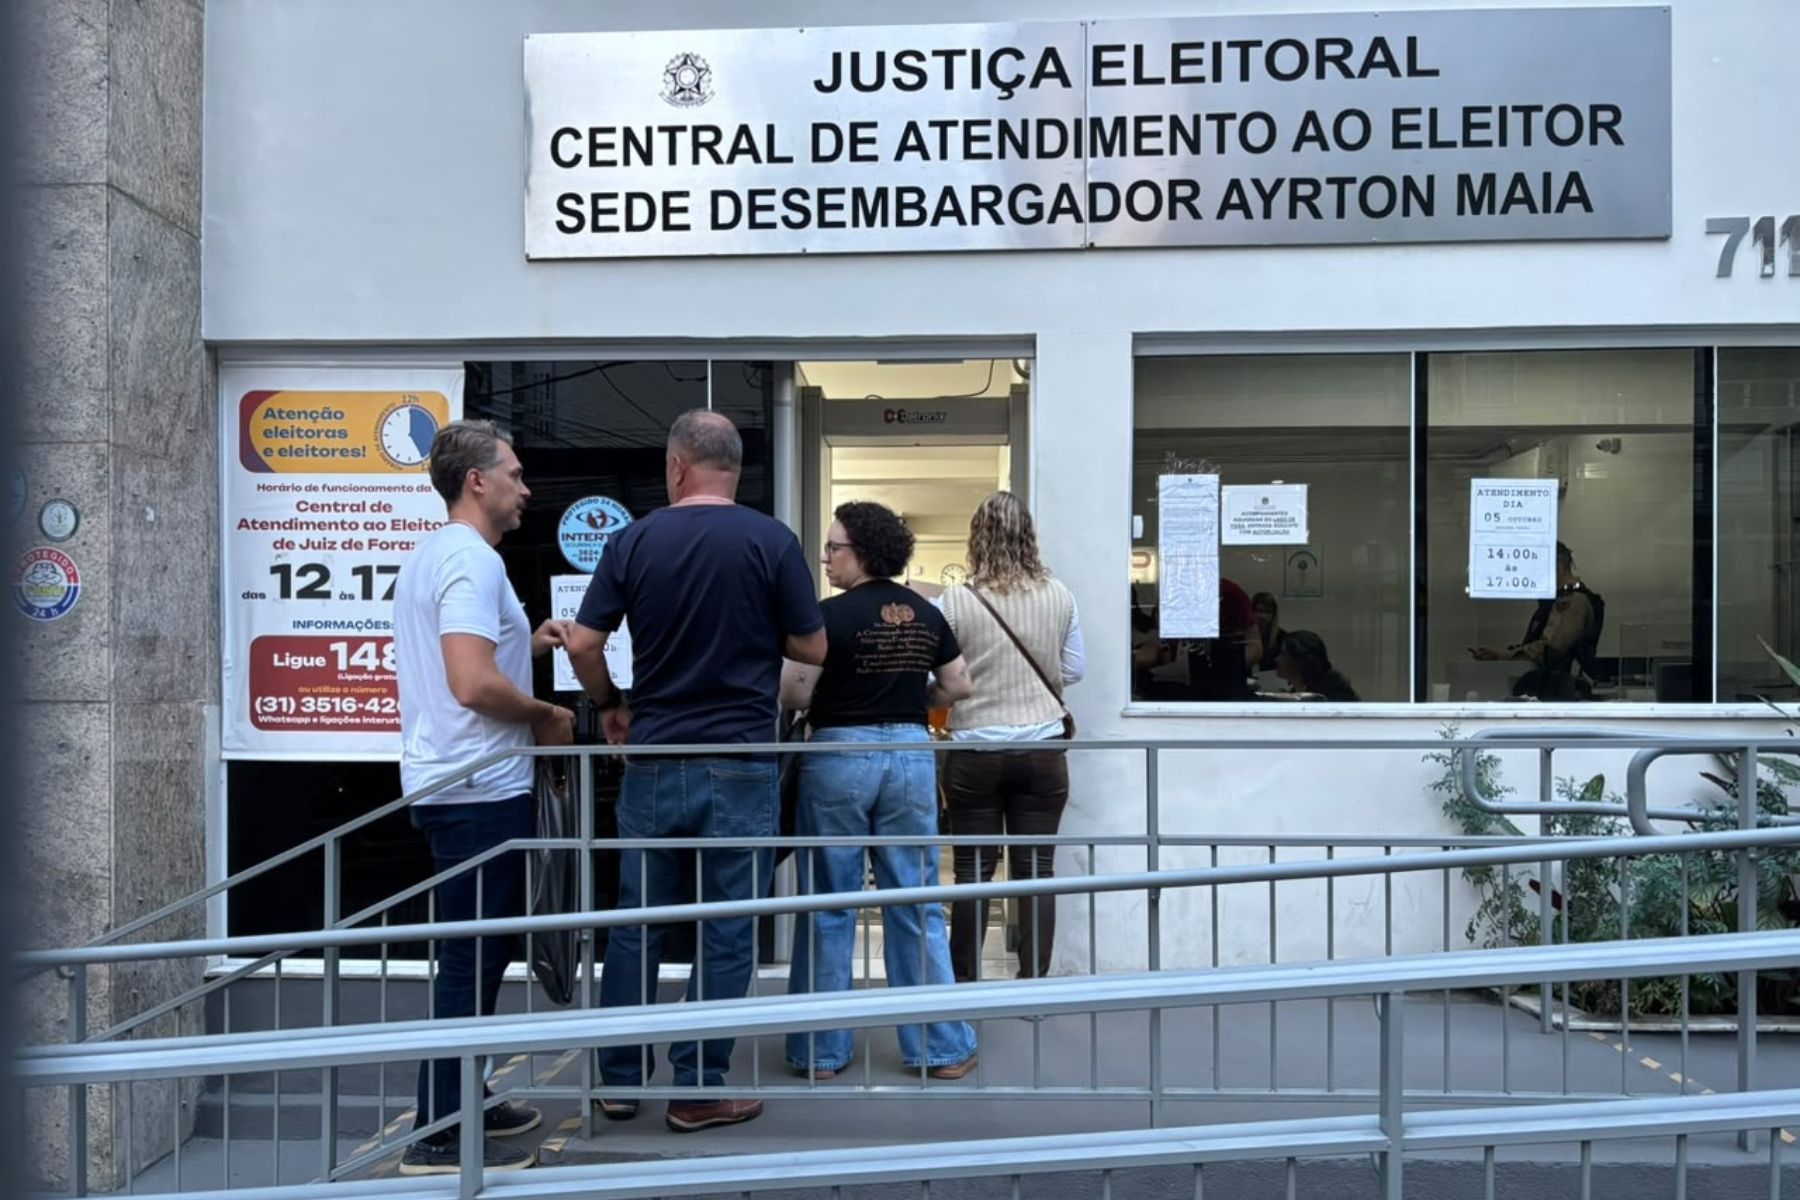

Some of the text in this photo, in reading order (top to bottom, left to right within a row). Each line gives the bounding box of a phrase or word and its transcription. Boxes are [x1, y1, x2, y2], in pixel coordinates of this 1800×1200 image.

[814, 36, 1440, 101] JUSTIÇA ELEITORAL
[550, 103, 1625, 169] CENTRAL DE ATENDIMENTO AO ELEITOR
[556, 170, 1594, 234] SEDE DESEMBARGADOR AYRTON MAIA
[1705, 215, 1800, 278] 711
[263, 407, 344, 423] Atenção
[263, 426, 348, 439] eleitoras
[263, 445, 367, 458] e eleitores!
[257, 483, 432, 493] Horário de funcionamento da
[1477, 489, 1550, 498] ATENDIMENTO
[296, 500, 393, 513] Central de
[562, 498, 599, 526] PROTEGIDO
[1484, 512, 1501, 522] 05
[237, 518, 359, 531] Atendimento
[363, 521, 387, 531] ao
[272, 537, 416, 551] de Juiz de Fora:
[241, 563, 401, 601] das 12 às 17
[562, 608, 577, 619] 05
[292, 619, 394, 632] INFORMAÇÕES:
[273, 653, 327, 669] Ligue
[298, 686, 311, 694] ou
[351, 685, 388, 694] número
[255, 696, 401, 714] (31) 3516-42
[258, 716, 311, 725] Whatsapp
[320, 715, 361, 726] ligações
